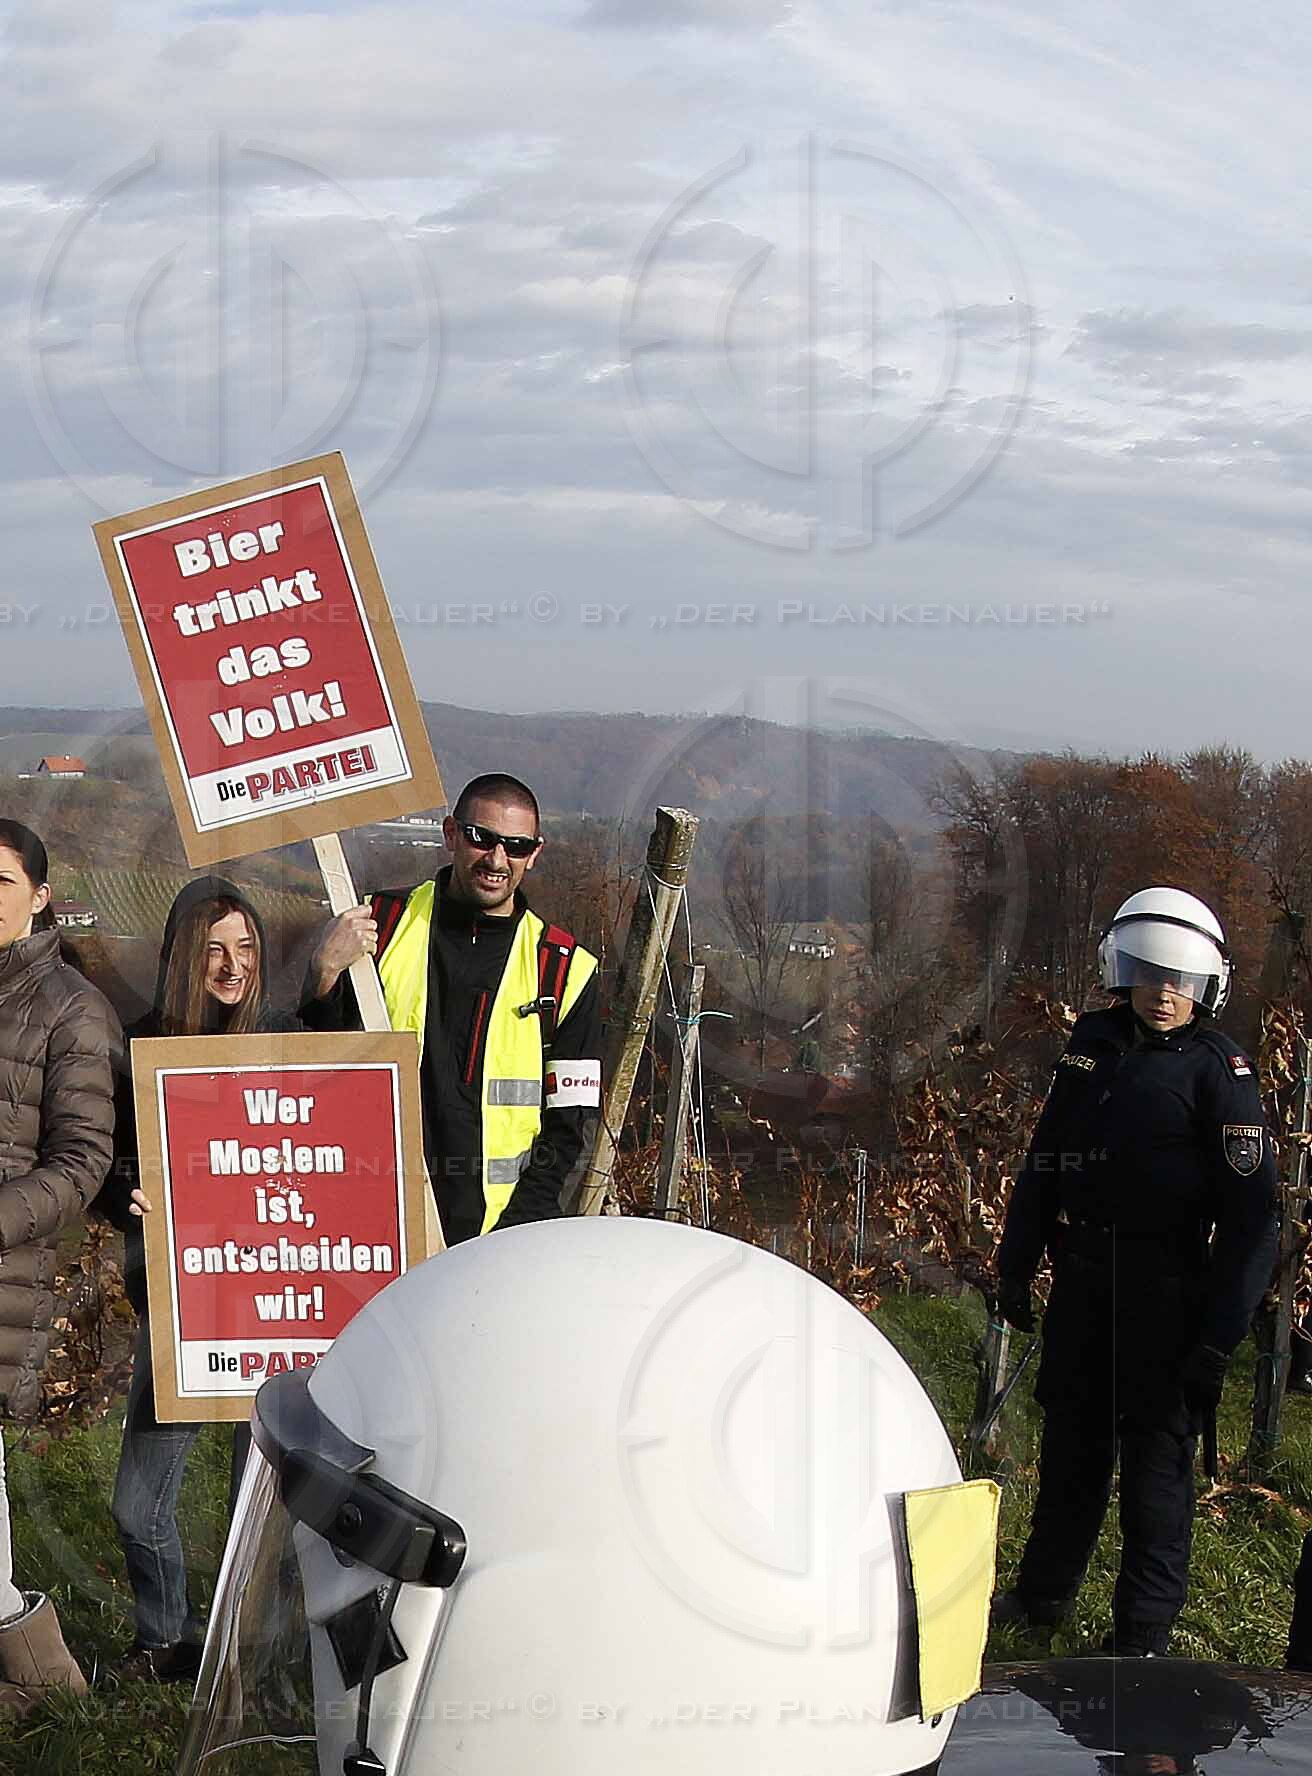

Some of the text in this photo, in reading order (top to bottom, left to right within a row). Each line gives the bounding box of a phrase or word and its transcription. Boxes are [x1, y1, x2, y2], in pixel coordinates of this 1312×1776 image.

[174, 520, 285, 577] Bier
[172, 568, 322, 638] trinkt
[217, 635, 311, 687] das
[208, 680, 348, 748] Volk!
[242, 1088, 315, 1125] Wer
[1226, 1127, 1260, 1139] POLIZEI
[208, 1138, 345, 1176] Moslem
[255, 1188, 316, 1229] ist,
[182, 1236, 394, 1275] entscheiden
[254, 1285, 326, 1323] wir!
[239, 1351, 328, 1381] PAR
